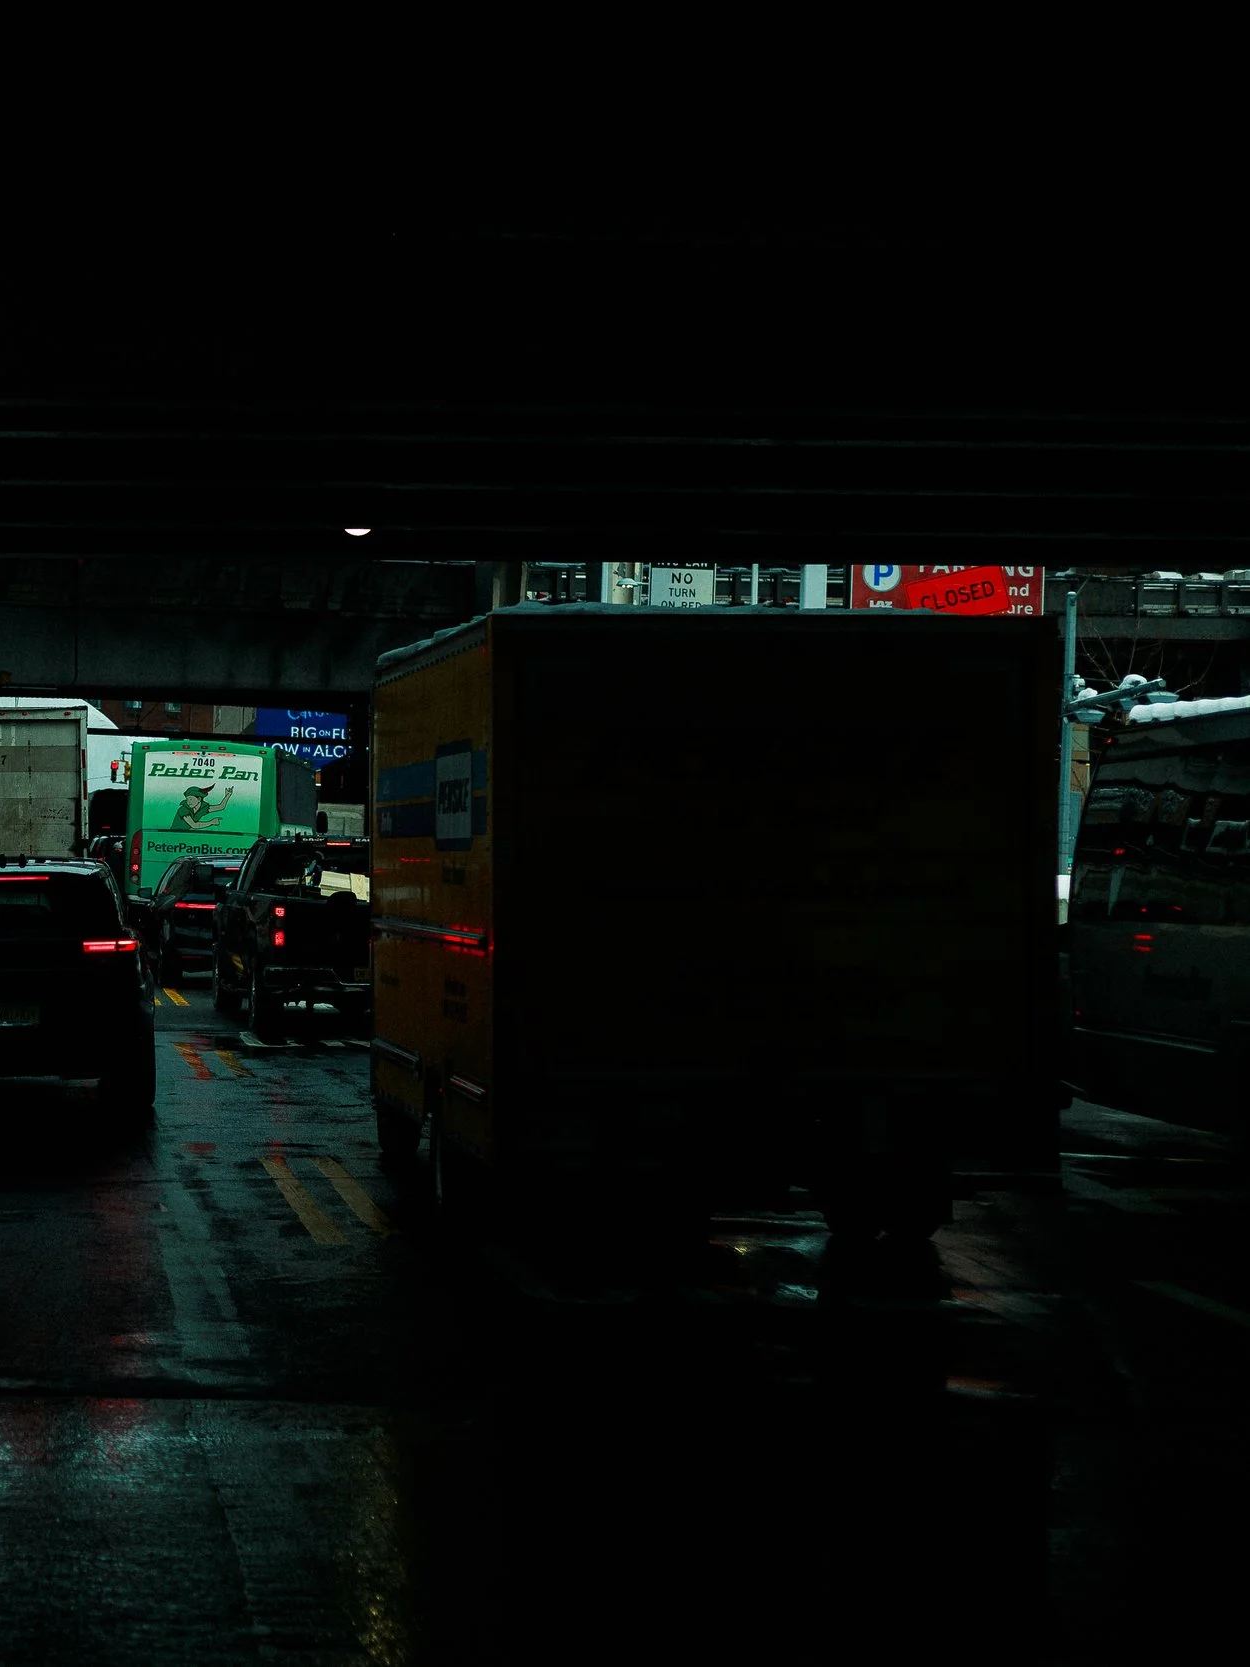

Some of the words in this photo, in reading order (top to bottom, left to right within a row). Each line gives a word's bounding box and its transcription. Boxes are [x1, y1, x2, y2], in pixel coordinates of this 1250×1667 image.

[672, 573, 693, 584] NO
[669, 588, 696, 597] TURN
[921, 581, 995, 610] CLOSED
[291, 727, 317, 738] BIG
[192, 758, 215, 767] 7040
[148, 763, 216, 779] Peter
[219, 766, 258, 781] Pan
[147, 842, 251, 856] PeterPanBus.com
